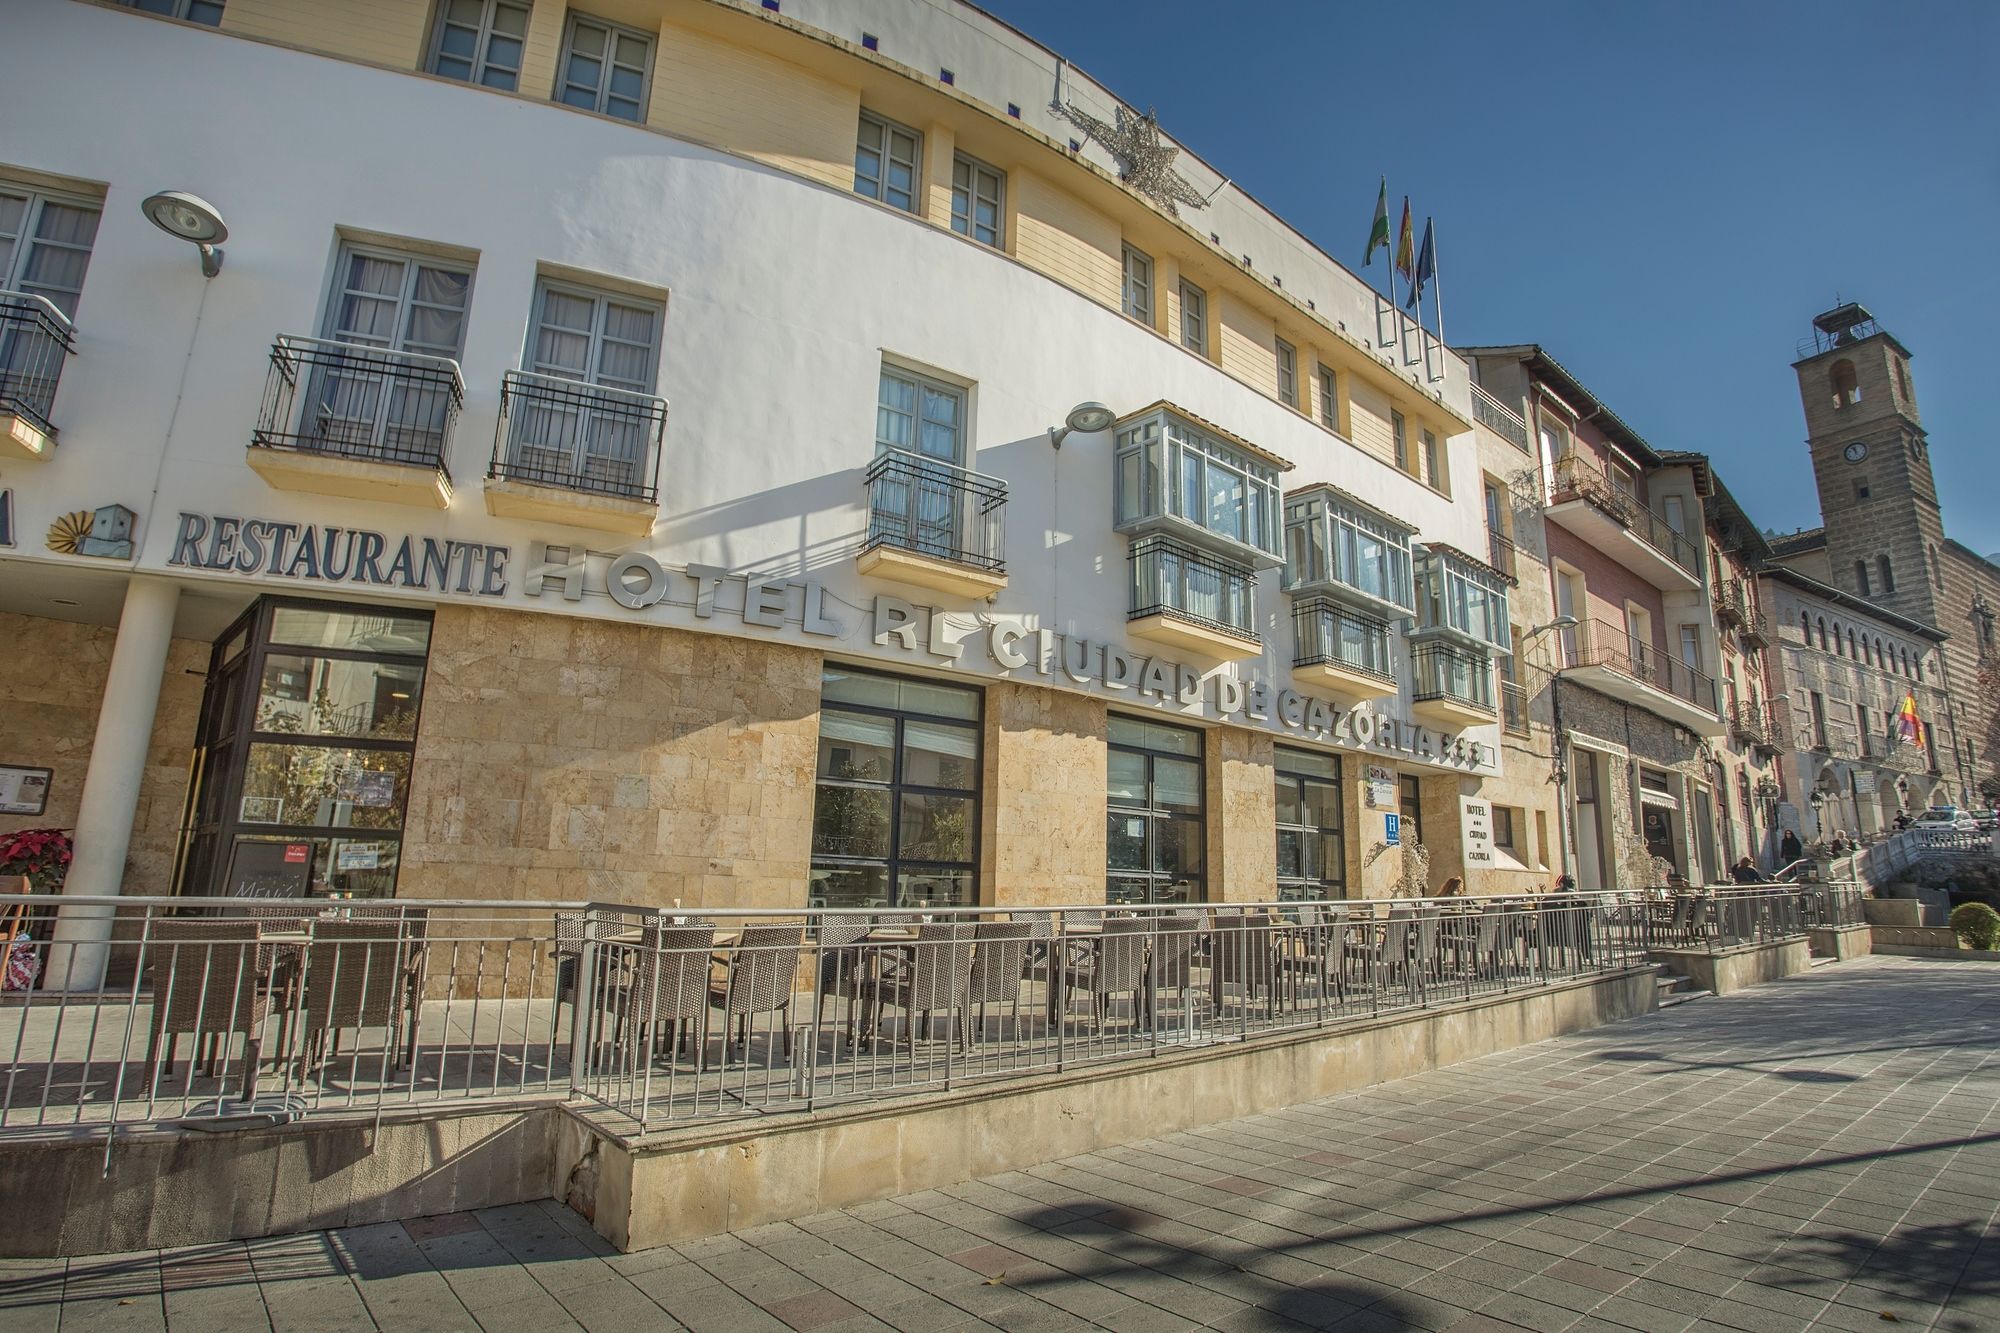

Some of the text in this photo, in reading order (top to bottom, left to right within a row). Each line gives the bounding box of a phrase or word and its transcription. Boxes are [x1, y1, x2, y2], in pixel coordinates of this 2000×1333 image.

[167, 511, 512, 598] RESTAURANTE
[524, 541, 1434, 757] HOTEL RL CIUDAD DE CAZORLA
[1466, 804, 1486, 816] HOTEL
[1388, 816, 1396, 832] H
[1469, 830, 1487, 840] CIUDAD
[1468, 851, 1490, 861] CAZORLA
